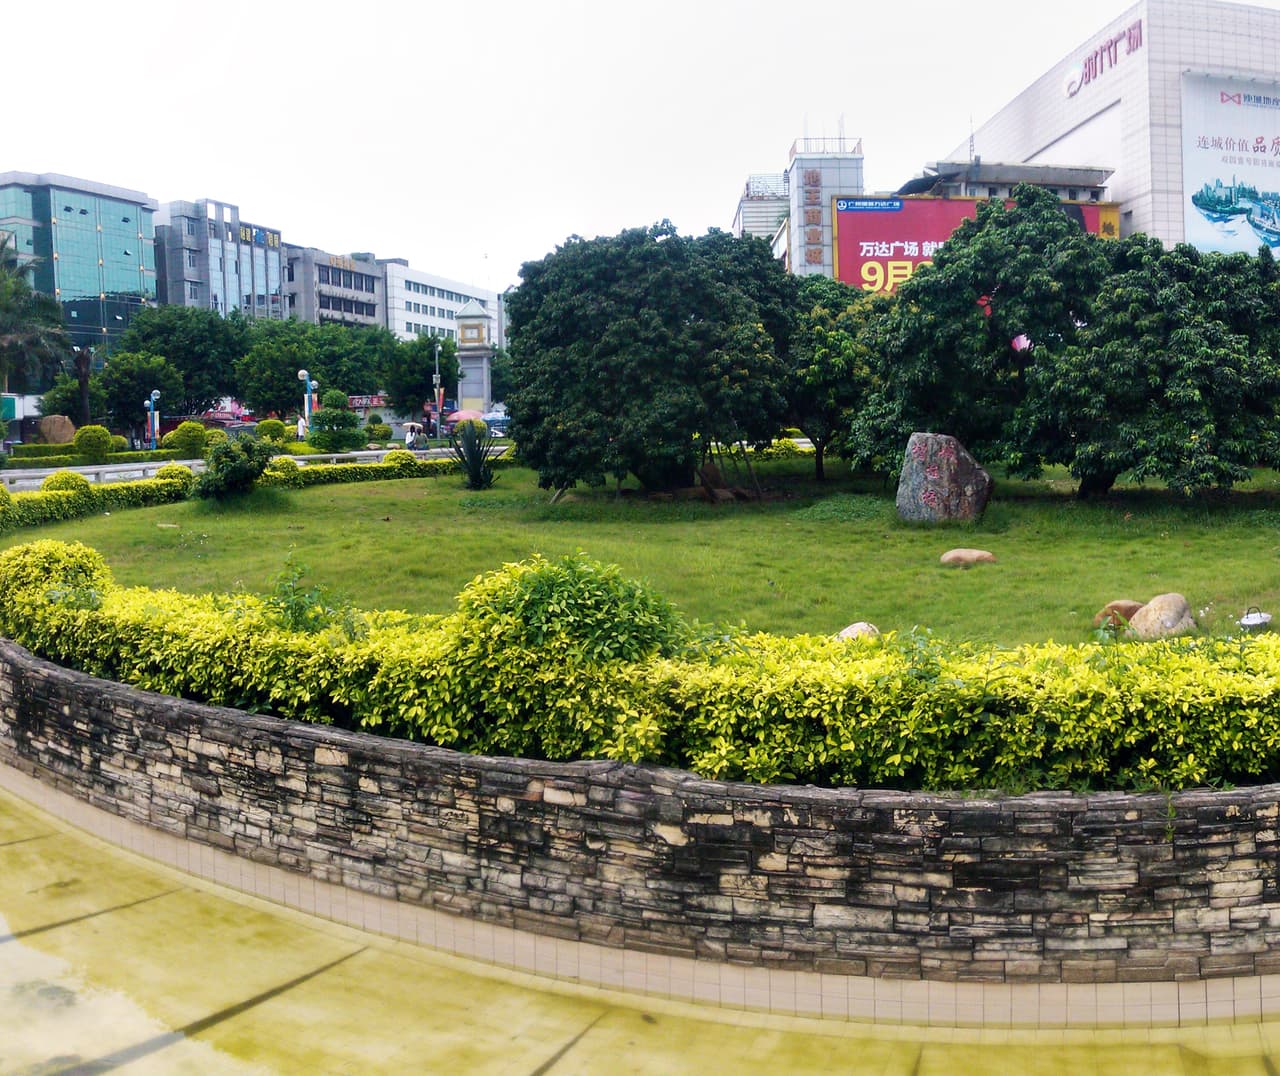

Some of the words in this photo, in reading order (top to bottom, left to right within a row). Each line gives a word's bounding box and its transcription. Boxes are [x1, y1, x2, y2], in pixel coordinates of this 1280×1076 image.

[1197, 136, 1250, 153] 连城价值
[859, 241, 919, 257] 万达广场
[861, 261, 933, 292] 9月
